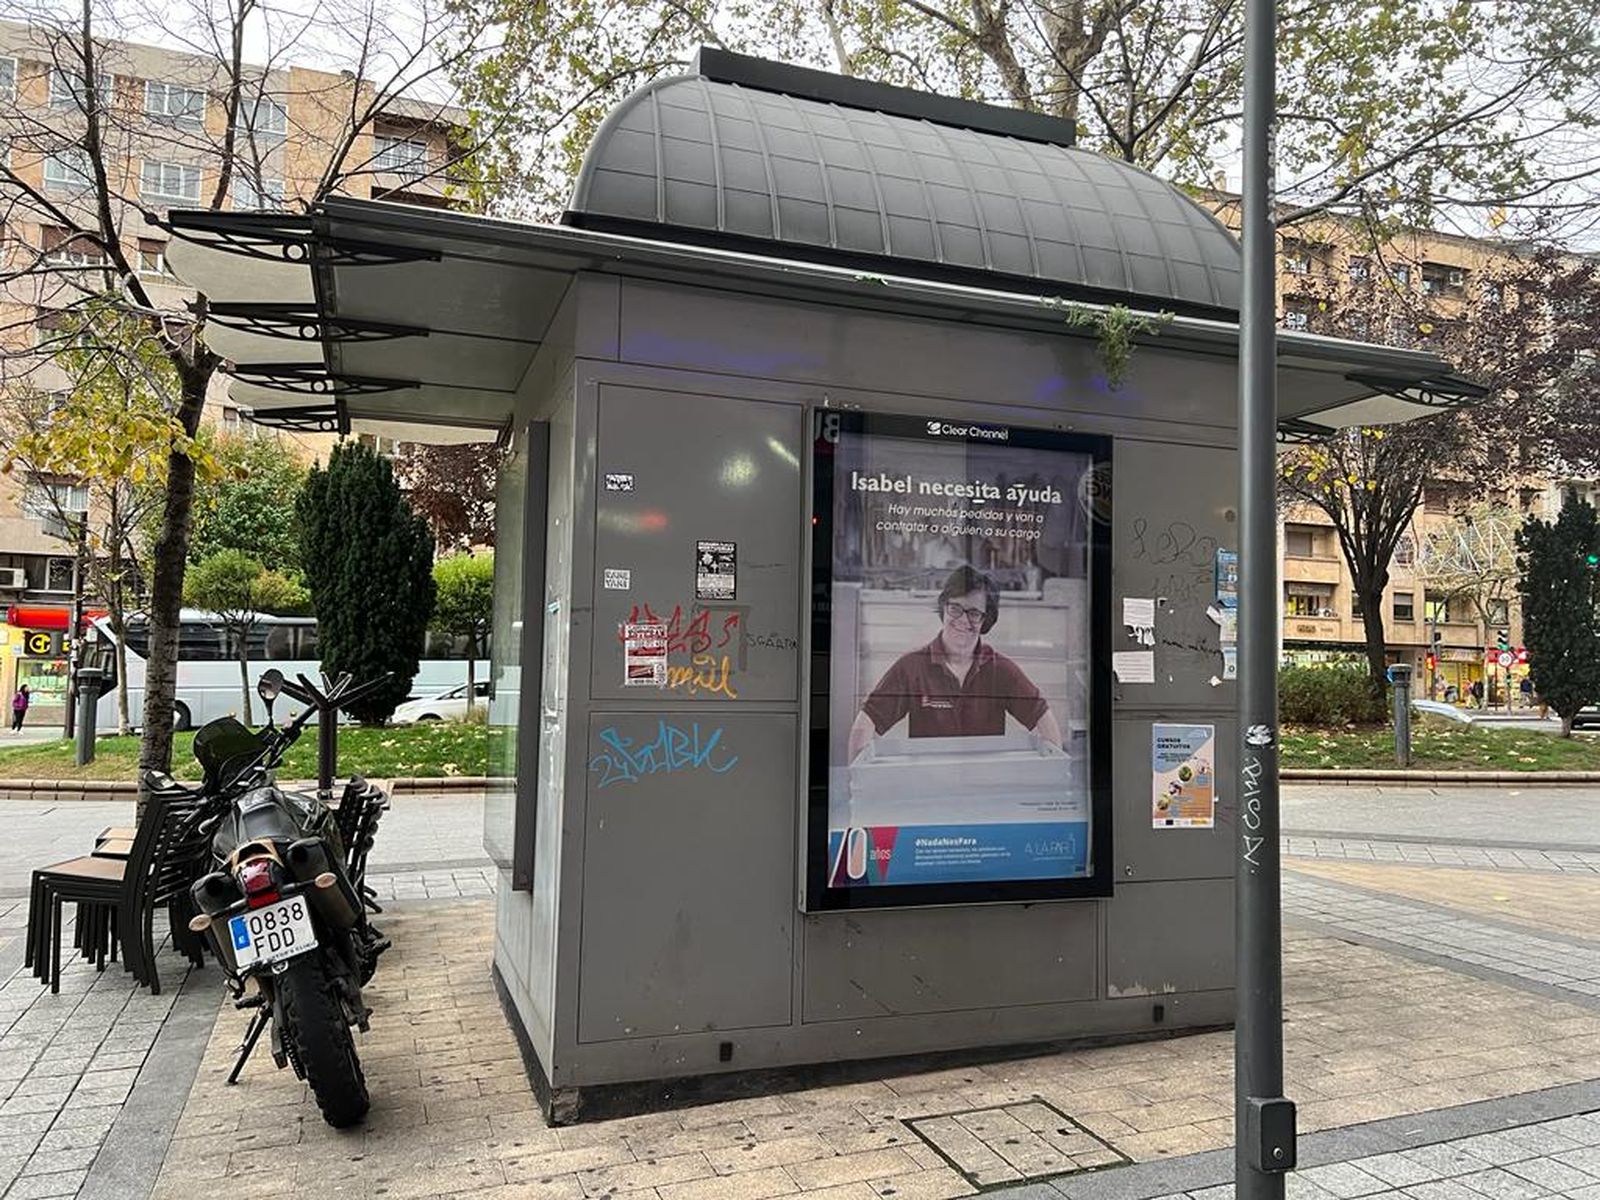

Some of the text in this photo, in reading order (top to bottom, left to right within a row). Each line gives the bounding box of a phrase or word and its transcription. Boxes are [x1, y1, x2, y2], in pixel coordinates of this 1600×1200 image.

[942, 424, 1008, 440] Clear Channel
[852, 472, 912, 493] Isabel
[920, 480, 1000, 503] necesita
[888, 504, 1044, 523] Hay muchos pedidos y van a
[876, 520, 1041, 541] contratar a alguien a su cargo
[249, 902, 304, 935] 0838
[253, 927, 295, 958] FDD
